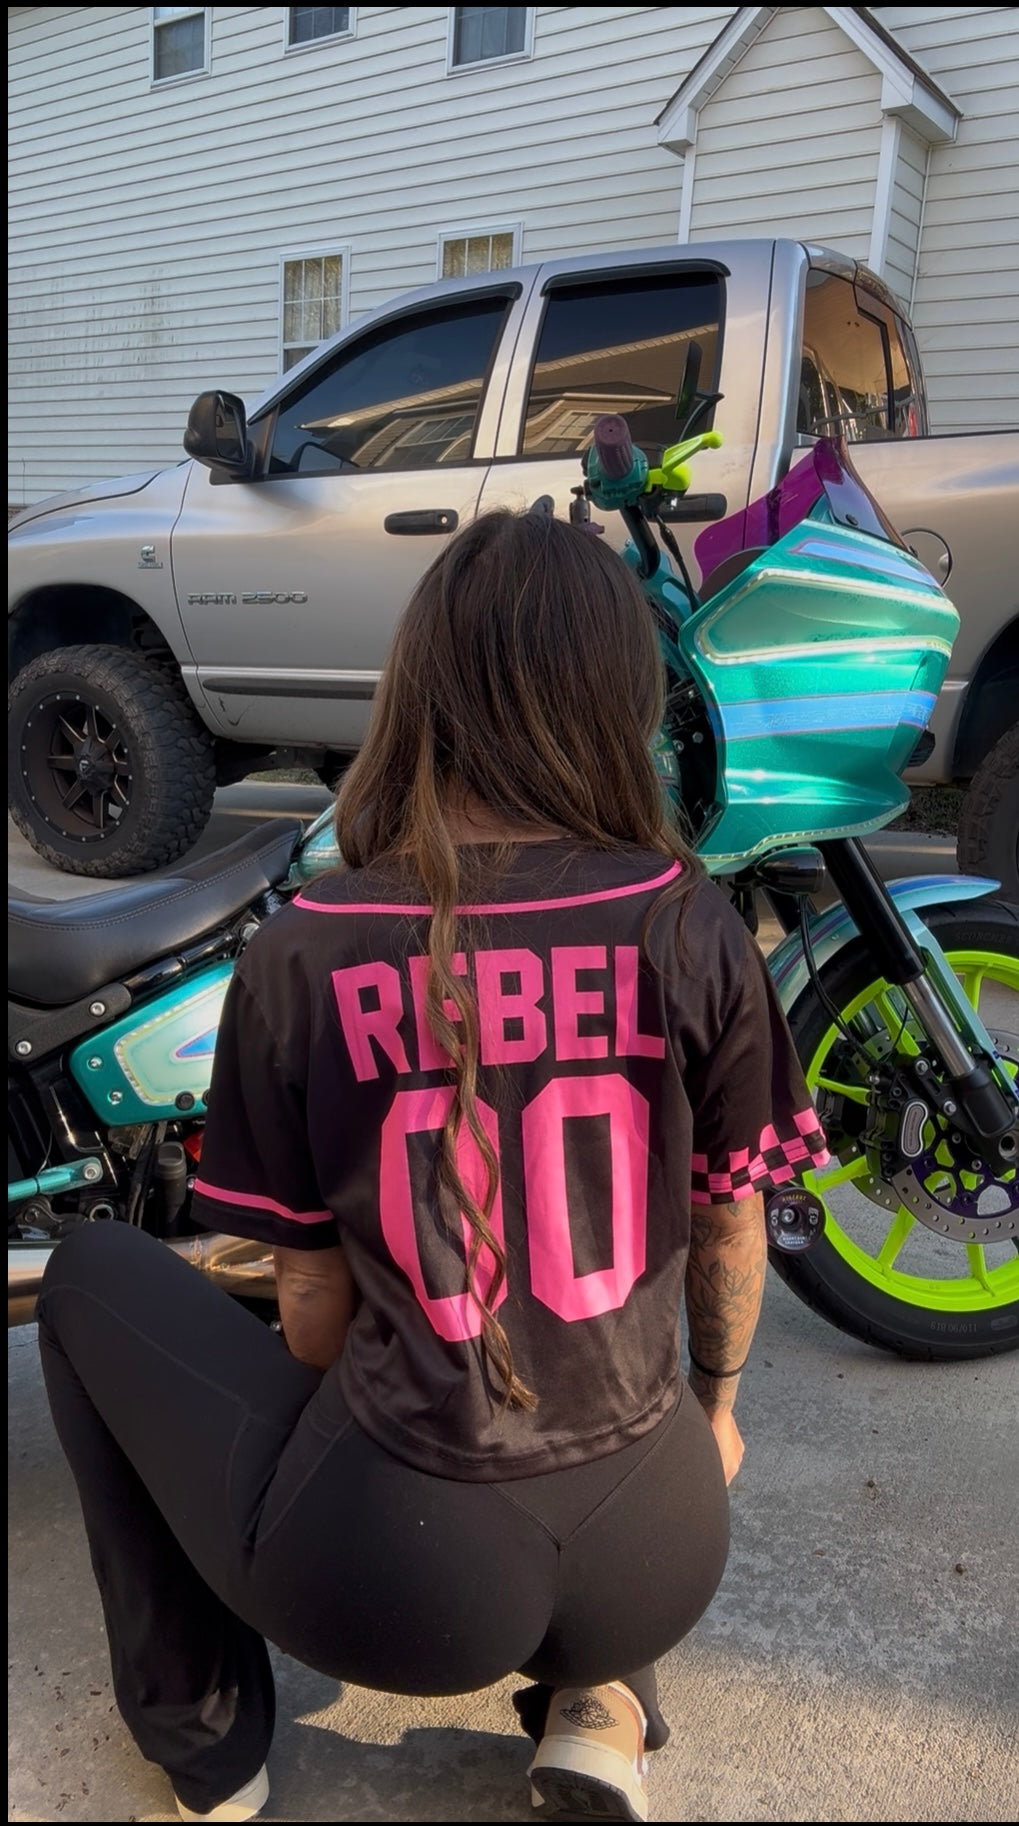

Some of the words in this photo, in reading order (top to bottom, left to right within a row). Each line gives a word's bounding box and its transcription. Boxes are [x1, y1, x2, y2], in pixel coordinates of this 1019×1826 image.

[187, 591, 237, 606] RAM
[241, 590, 308, 605] 2500
[332, 946, 665, 1082] REBEL
[380, 1073, 650, 1342] 00
